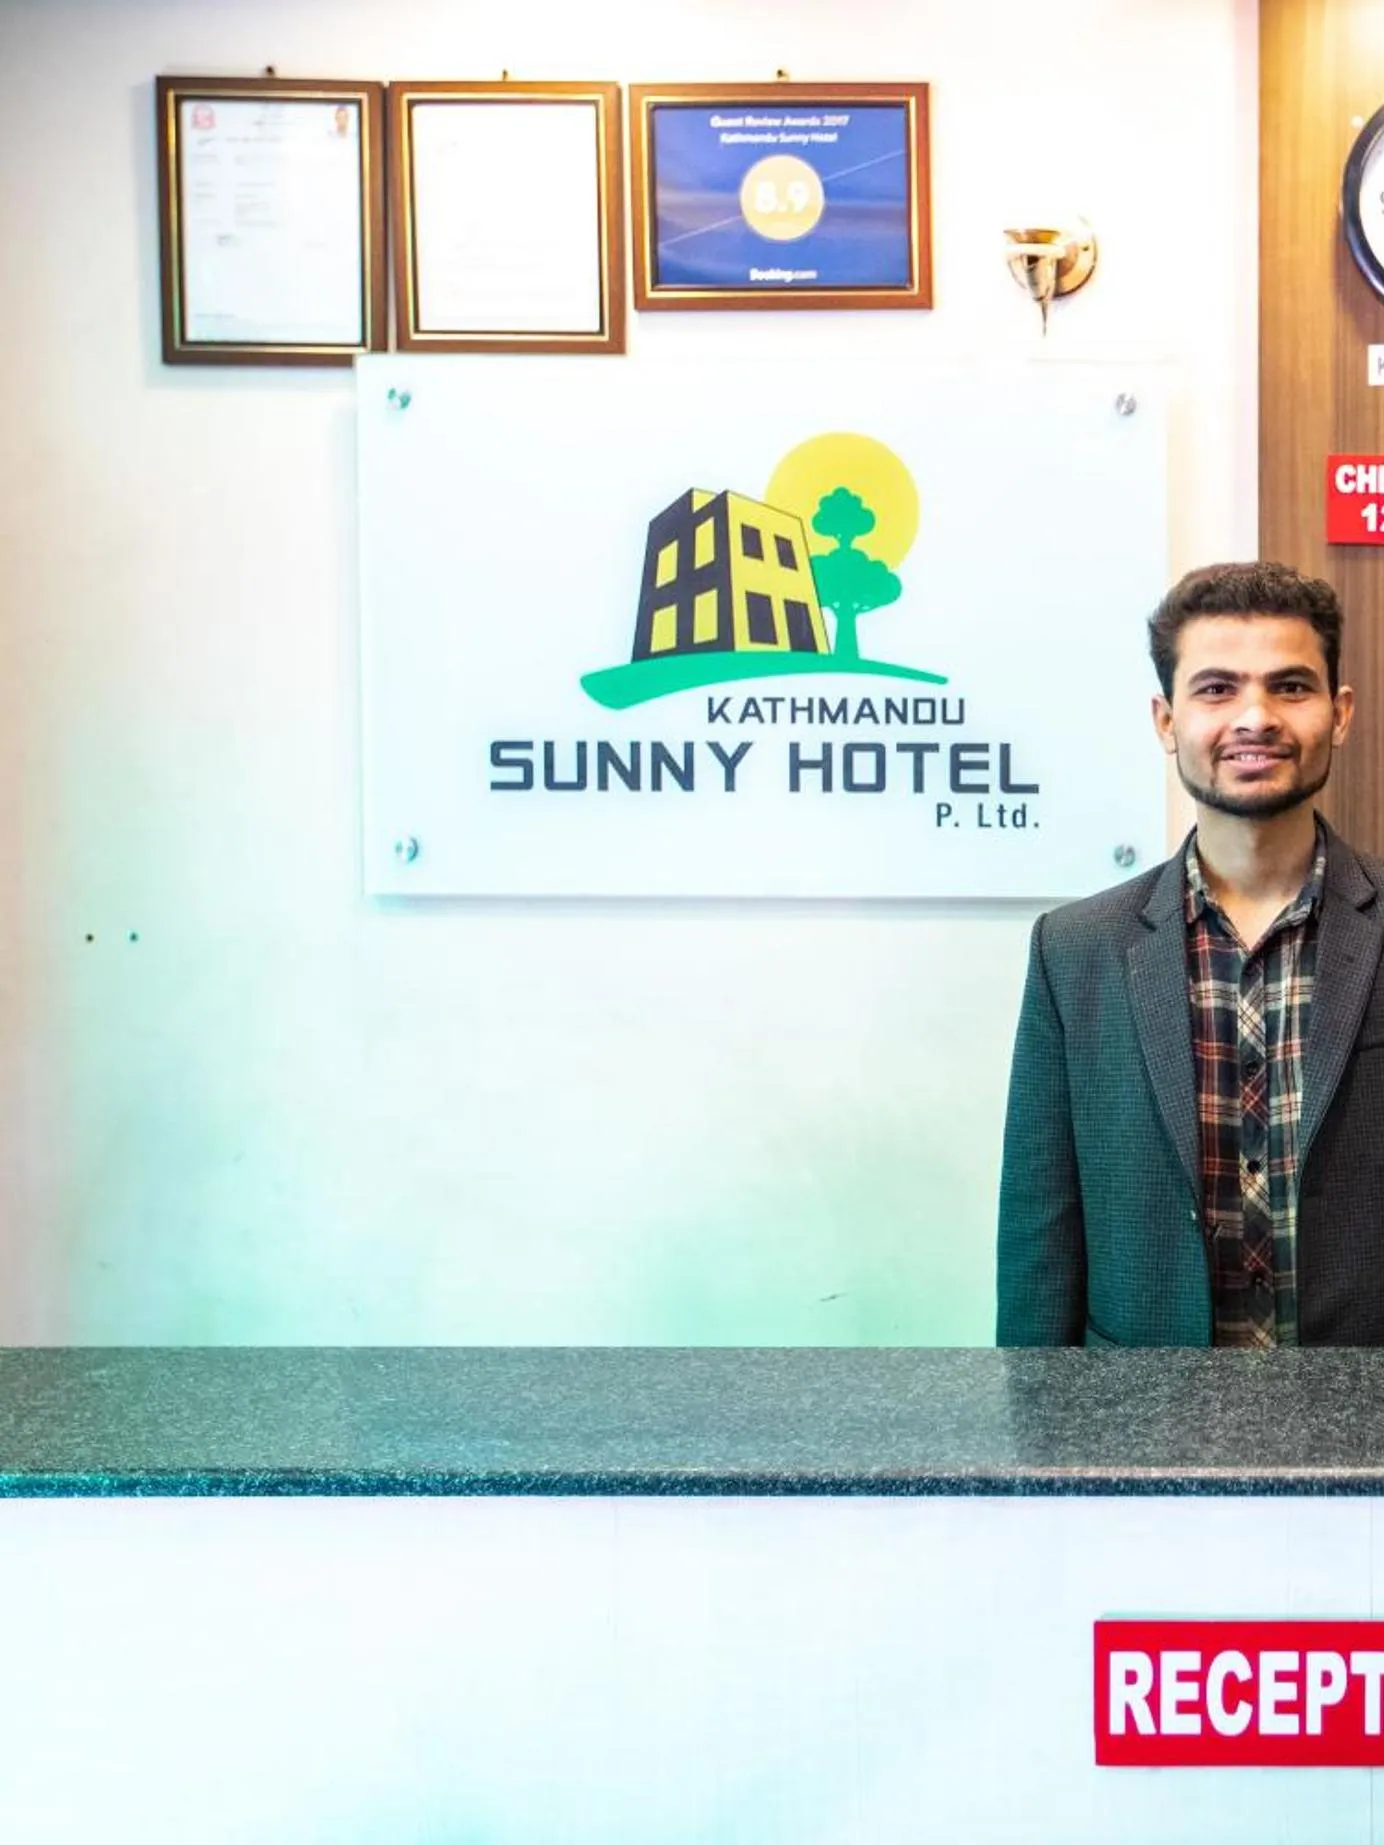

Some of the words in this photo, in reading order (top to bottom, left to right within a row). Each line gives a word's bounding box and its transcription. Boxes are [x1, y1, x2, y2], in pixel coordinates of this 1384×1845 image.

[754, 181, 810, 213] 8.9
[708, 697, 965, 725] KATHMANDU
[490, 740, 753, 791] SUNNY
[789, 742, 1039, 794] HOTEL
[936, 803, 959, 827] P.
[977, 803, 1040, 828] Ltd.
